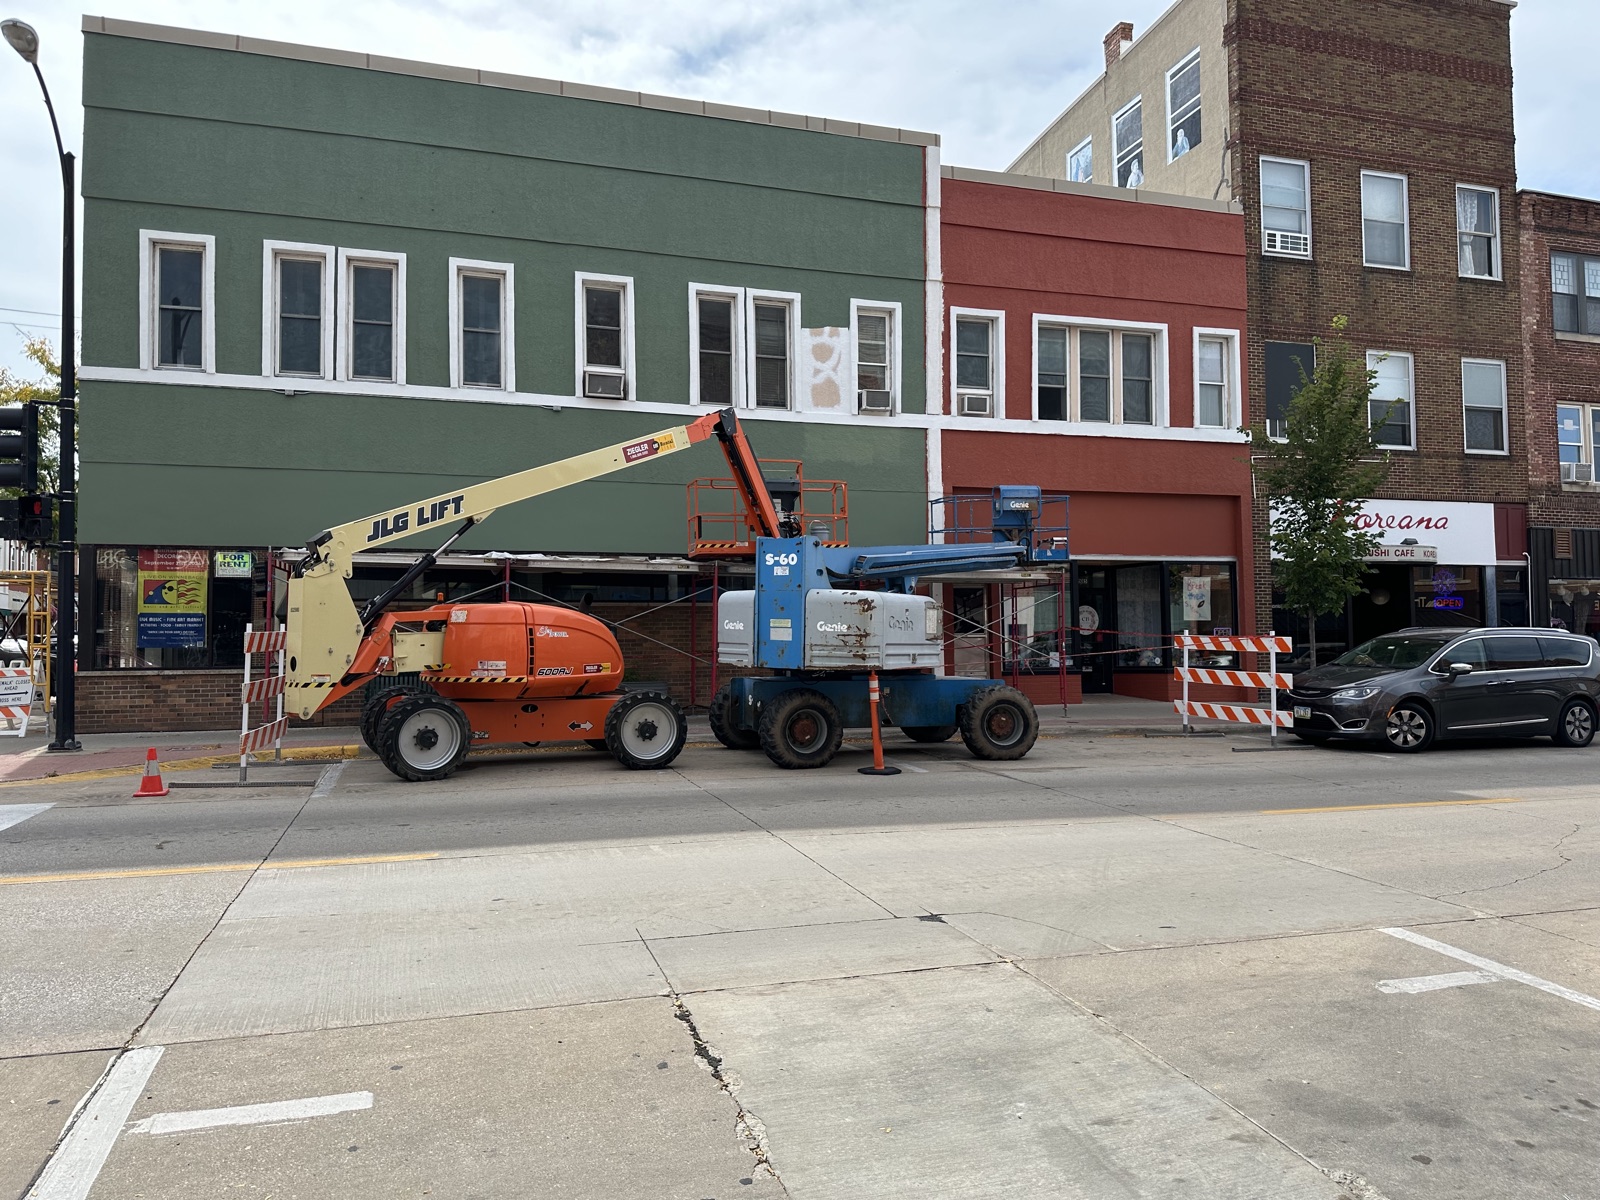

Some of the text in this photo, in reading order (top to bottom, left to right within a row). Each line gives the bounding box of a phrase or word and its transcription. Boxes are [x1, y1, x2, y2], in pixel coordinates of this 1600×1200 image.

[626, 443, 649, 456] ZIEGLER
[1010, 501, 1030, 509] Genie
[366, 494, 465, 543] JLG LIFT
[1364, 549, 1389, 557] USHI
[765, 553, 798, 566] S-60
[1436, 598, 1461, 607] OPEN
[724, 619, 744, 630] Genie
[816, 620, 848, 632] Genie
[537, 667, 573, 676] 600AJ
